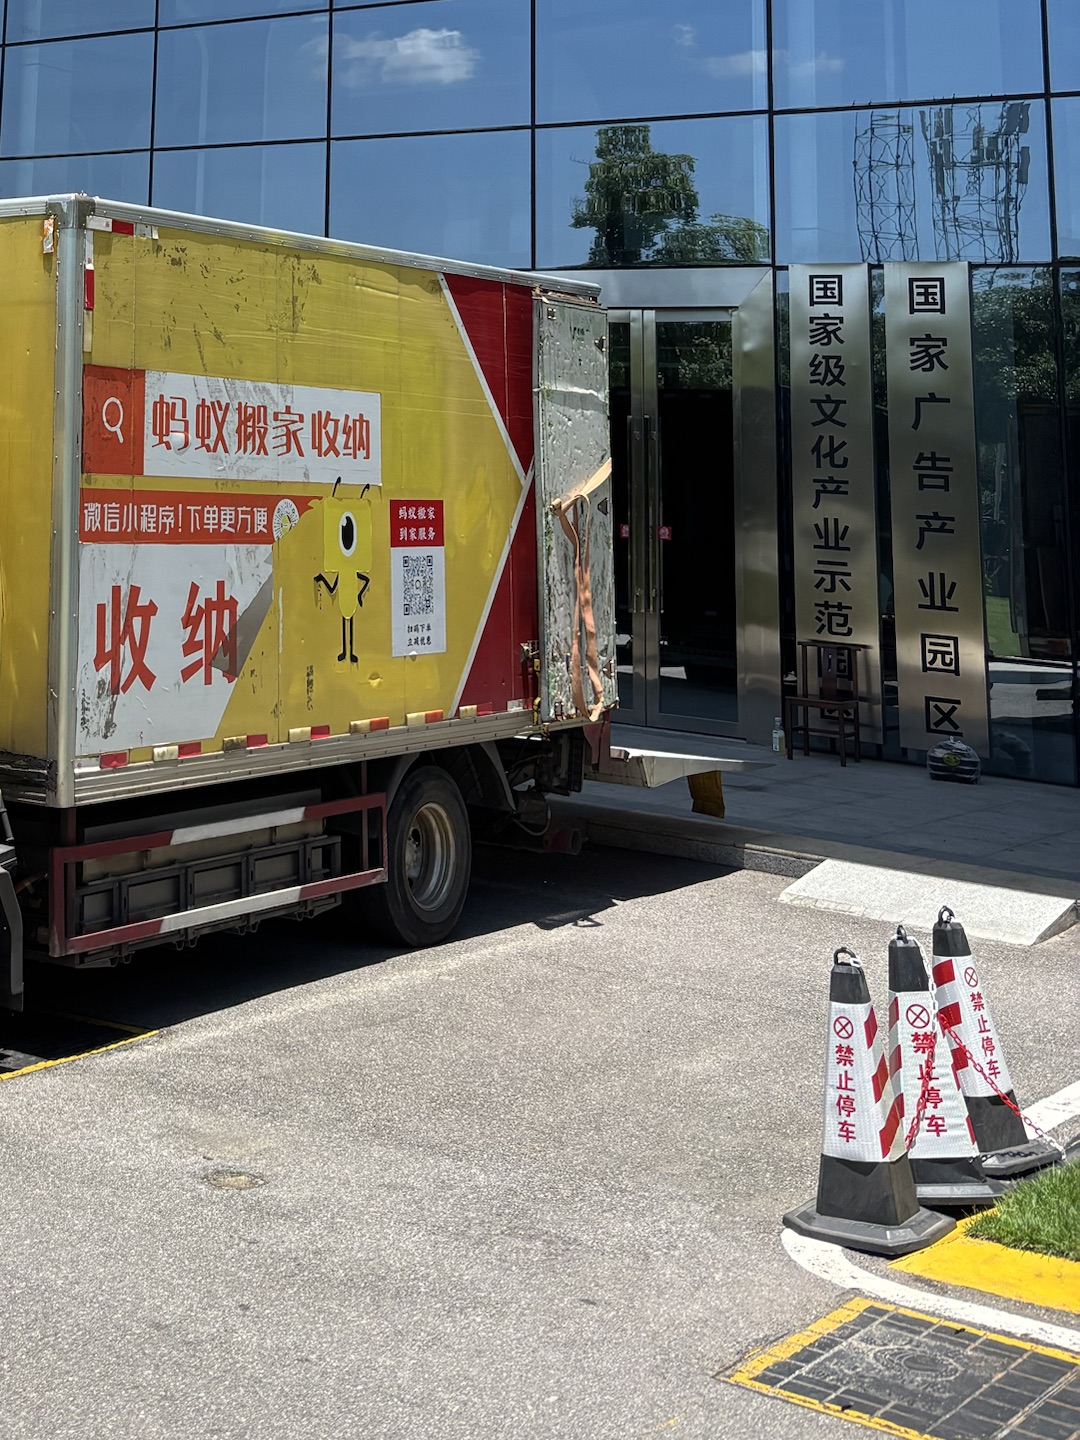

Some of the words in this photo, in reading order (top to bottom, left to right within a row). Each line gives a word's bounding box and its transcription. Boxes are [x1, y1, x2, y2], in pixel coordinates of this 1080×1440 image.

[151, 394, 372, 459] 蚂蚁搬家收纳
[398, 506, 436, 520] 蚂蚁搬家
[399, 526, 436, 542] 到家服务
[907, 276, 963, 738] 国家广告产业园区
[93, 580, 240, 695] 收纳
[970, 991, 1001, 1080] 禁止停车
[835, 1043, 856, 1143] 禁止停车
